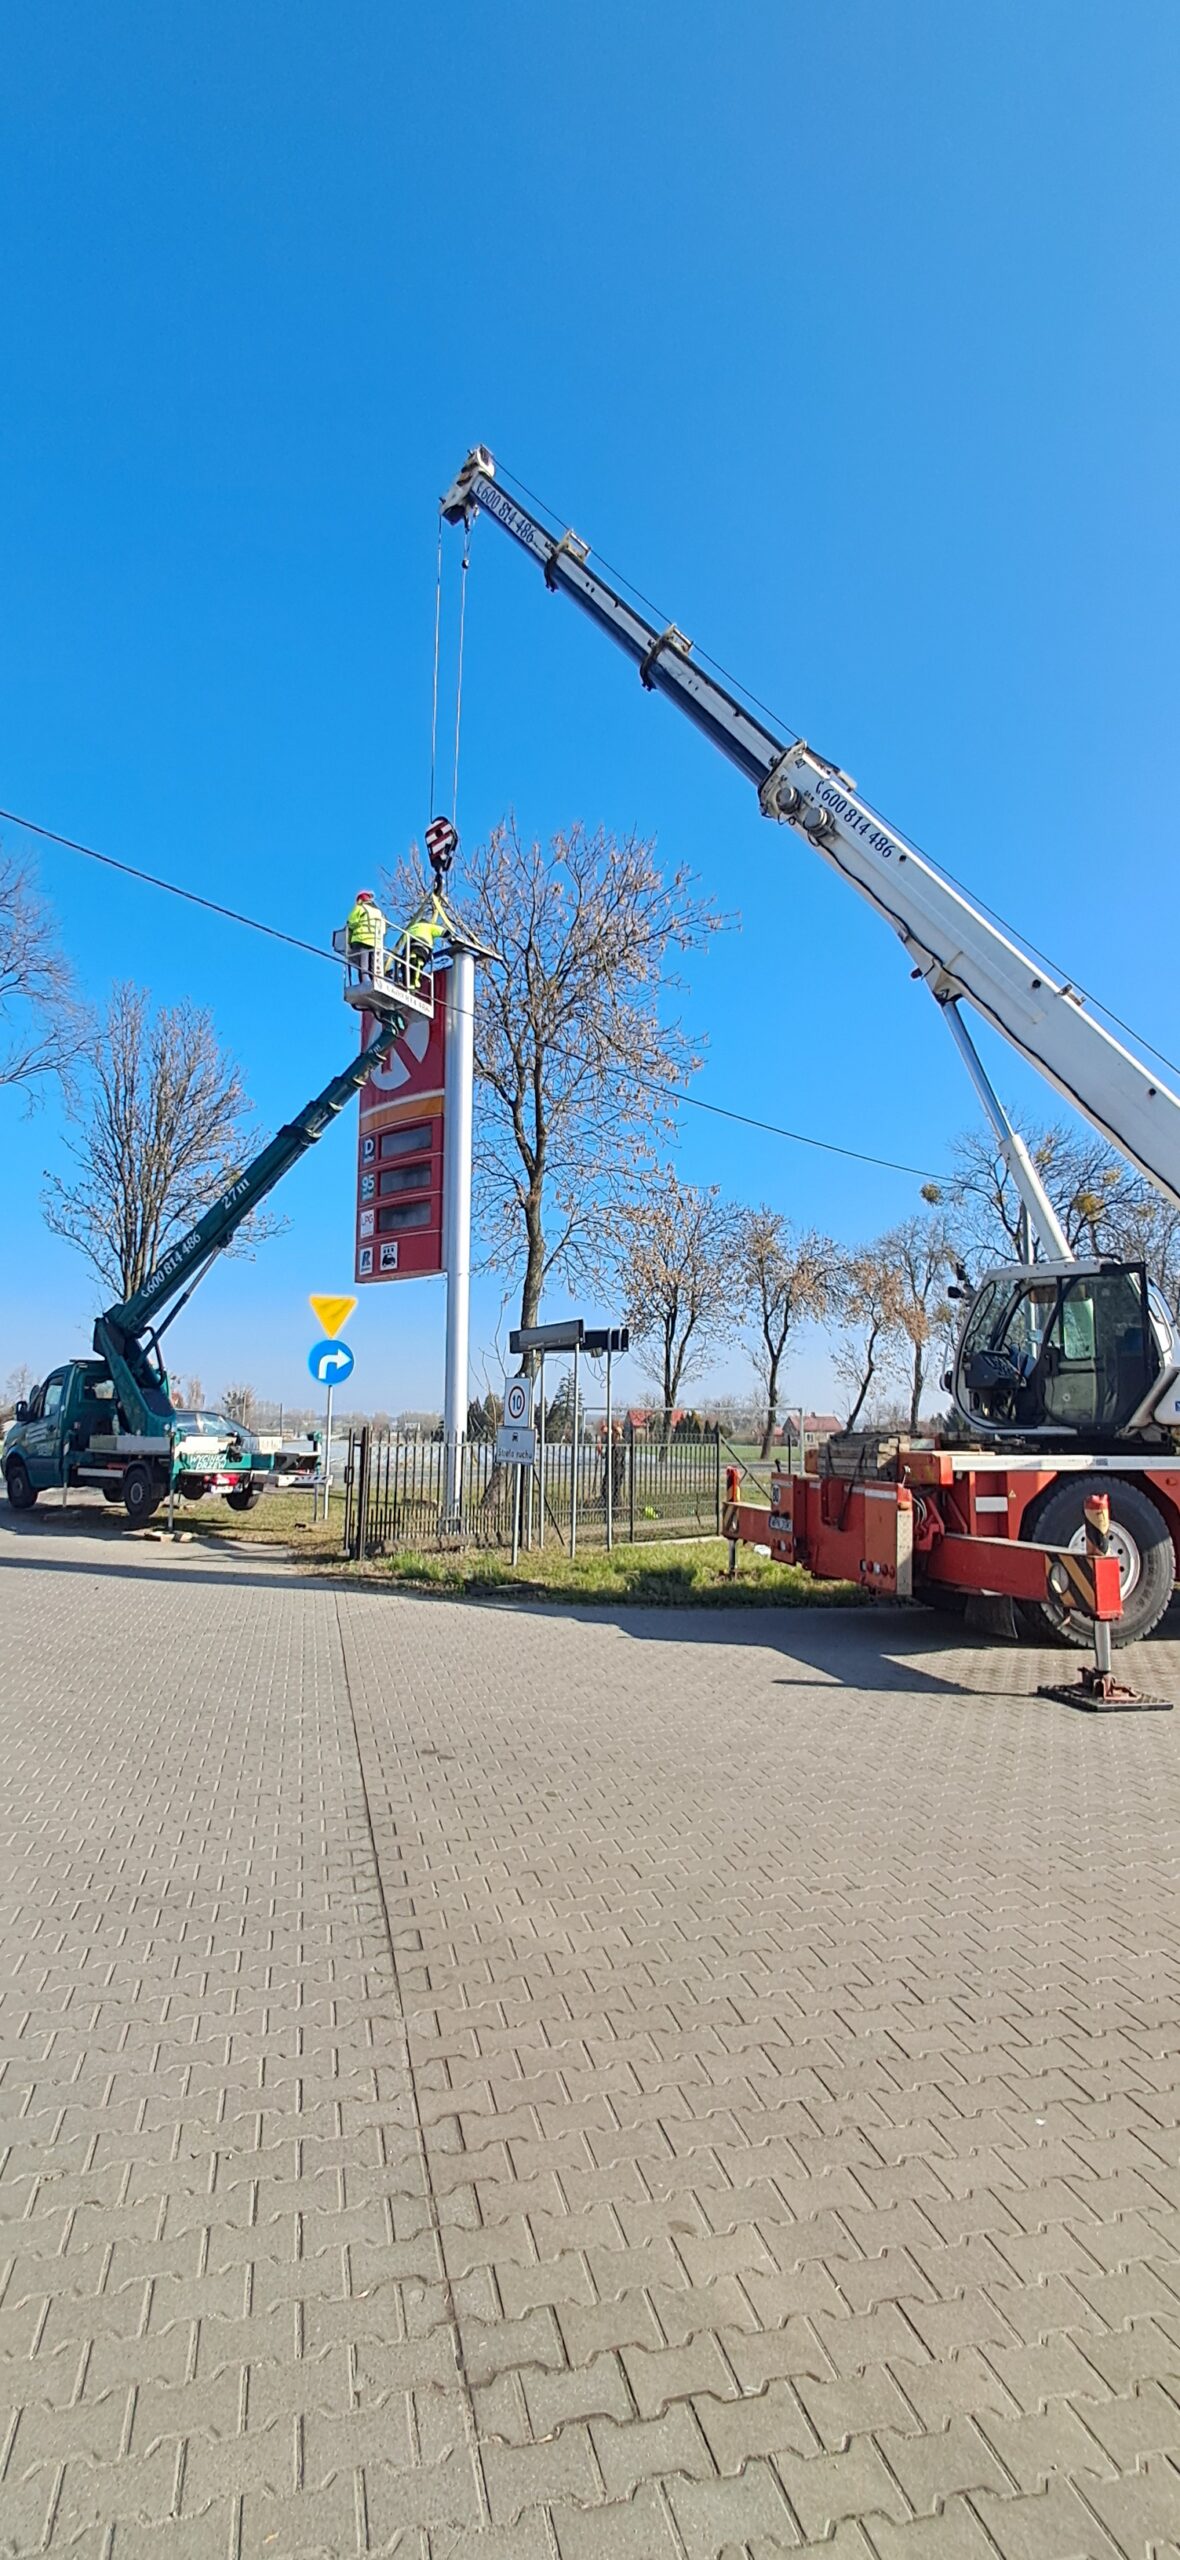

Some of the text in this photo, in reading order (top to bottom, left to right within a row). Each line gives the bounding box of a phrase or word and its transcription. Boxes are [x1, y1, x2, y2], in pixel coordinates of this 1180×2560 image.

[481, 487, 536, 543] 600 814 486
[821, 788, 897, 858] 600 814 486
[364, 1138, 374, 1154] D
[221, 1178, 250, 1210] 27m
[361, 1174, 375, 1192] 95
[146, 1231, 201, 1294] 600 814 486
[512, 1395, 523, 1410] 10
